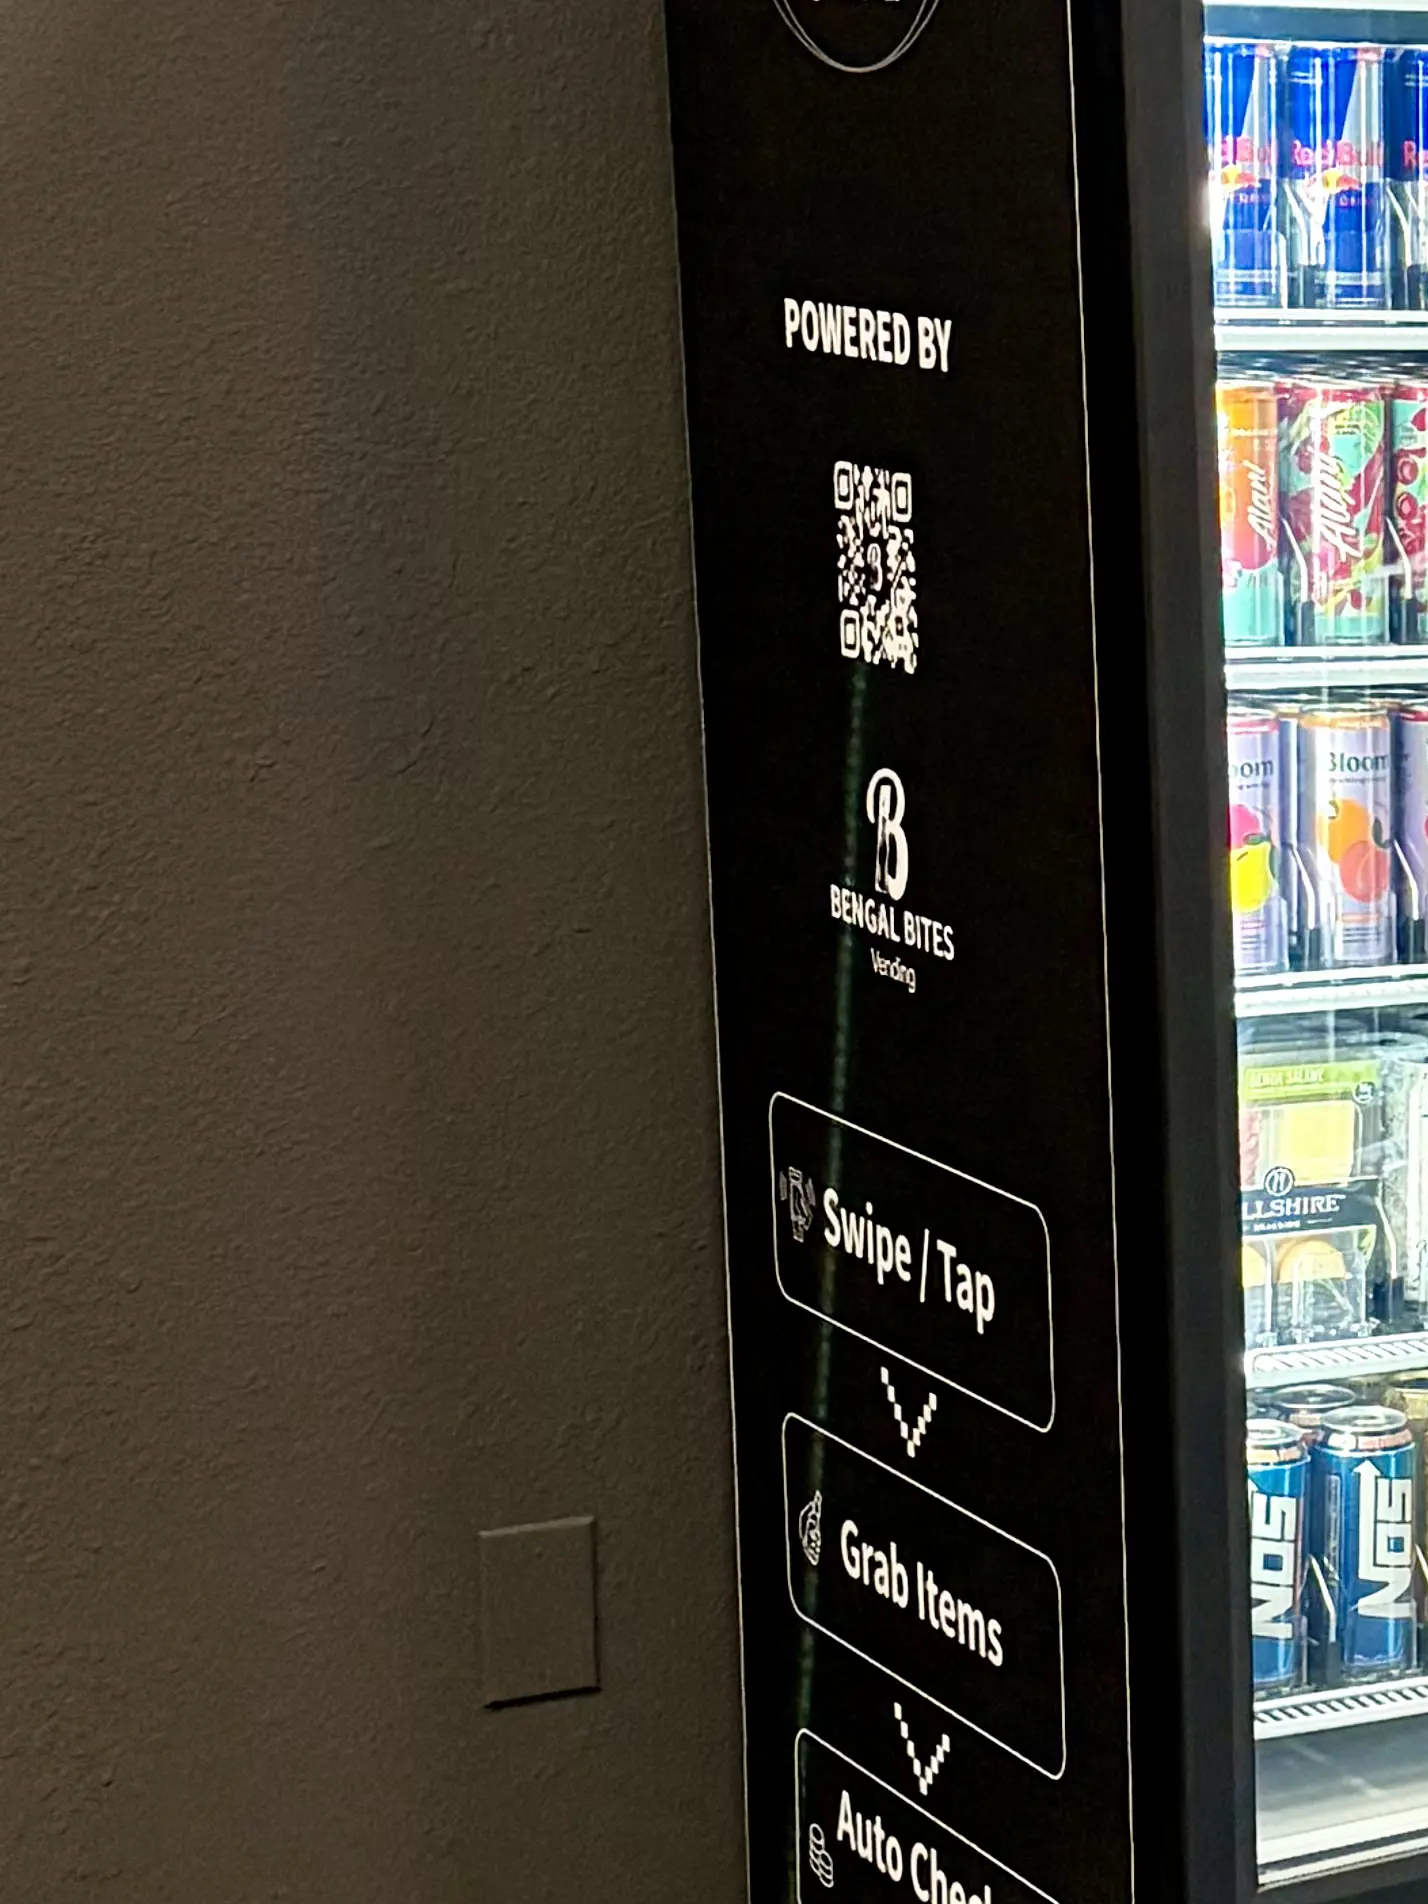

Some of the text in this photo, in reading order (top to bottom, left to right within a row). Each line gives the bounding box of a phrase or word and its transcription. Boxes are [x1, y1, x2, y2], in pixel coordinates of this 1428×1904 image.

[784, 298, 953, 372] POWERED BY
[831, 884, 954, 960] BENGAL BITES
[871, 948, 916, 993] Vending
[824, 1188, 995, 1334] Swipe / Tap
[1355, 1460, 1412, 1619] NOS
[841, 1520, 1003, 1666] Grab Items
[837, 1790, 902, 1881] Auto
